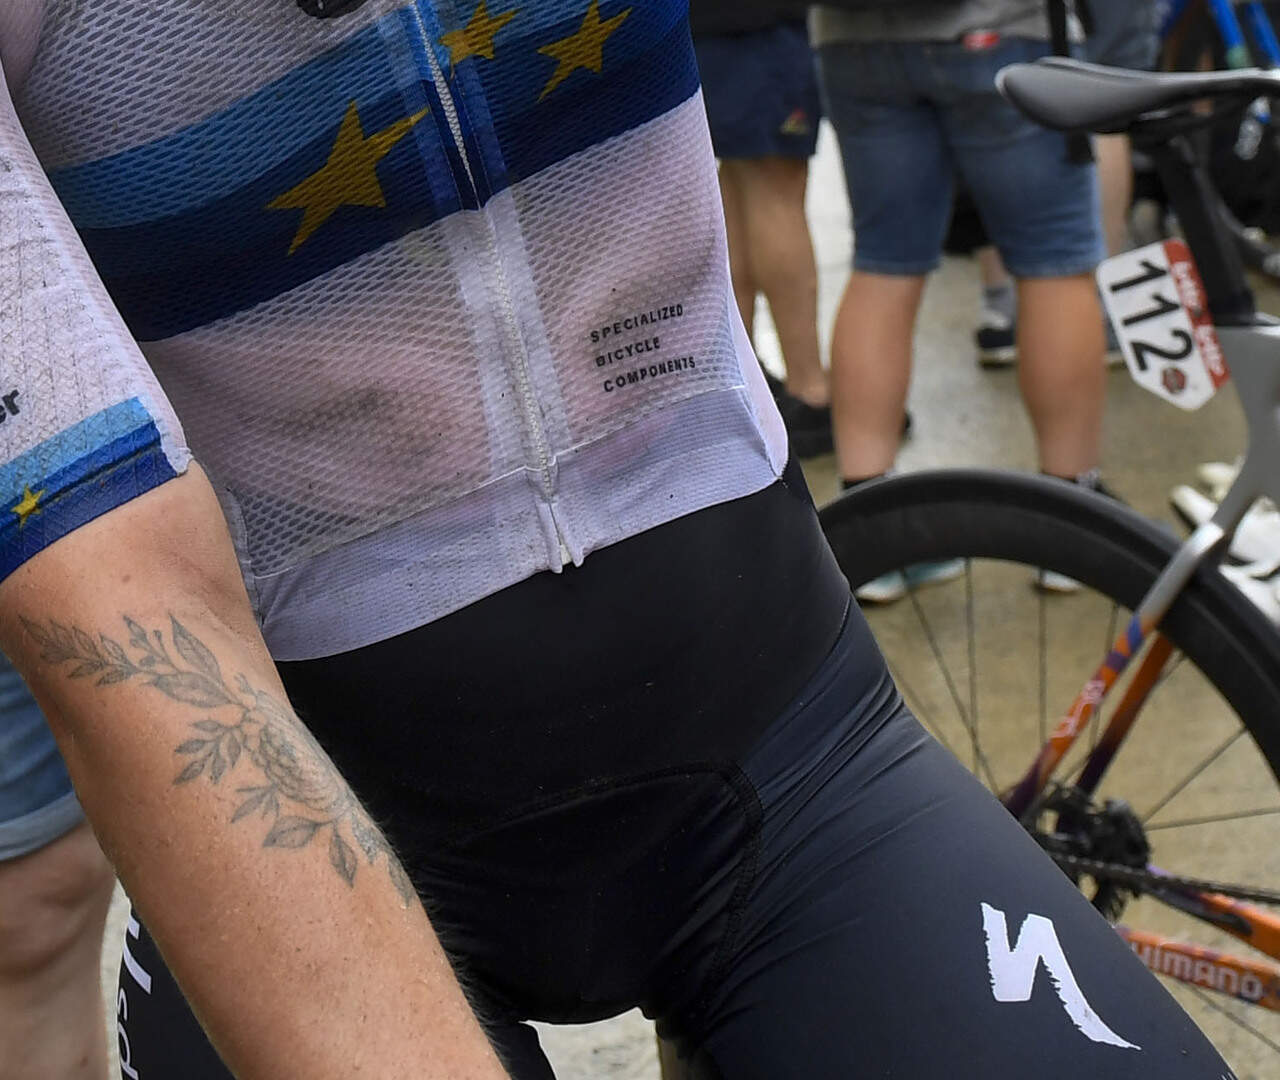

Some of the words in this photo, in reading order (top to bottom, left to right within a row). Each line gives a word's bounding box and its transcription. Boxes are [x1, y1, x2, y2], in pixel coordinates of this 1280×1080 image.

[589, 303, 684, 344] SPECIALIZED
[1109, 259, 1194, 372] 112
[595, 336, 661, 368] BICYCLE
[603, 355, 696, 393] COMPONENTS
[1130, 940, 1265, 1002] HIMANO
